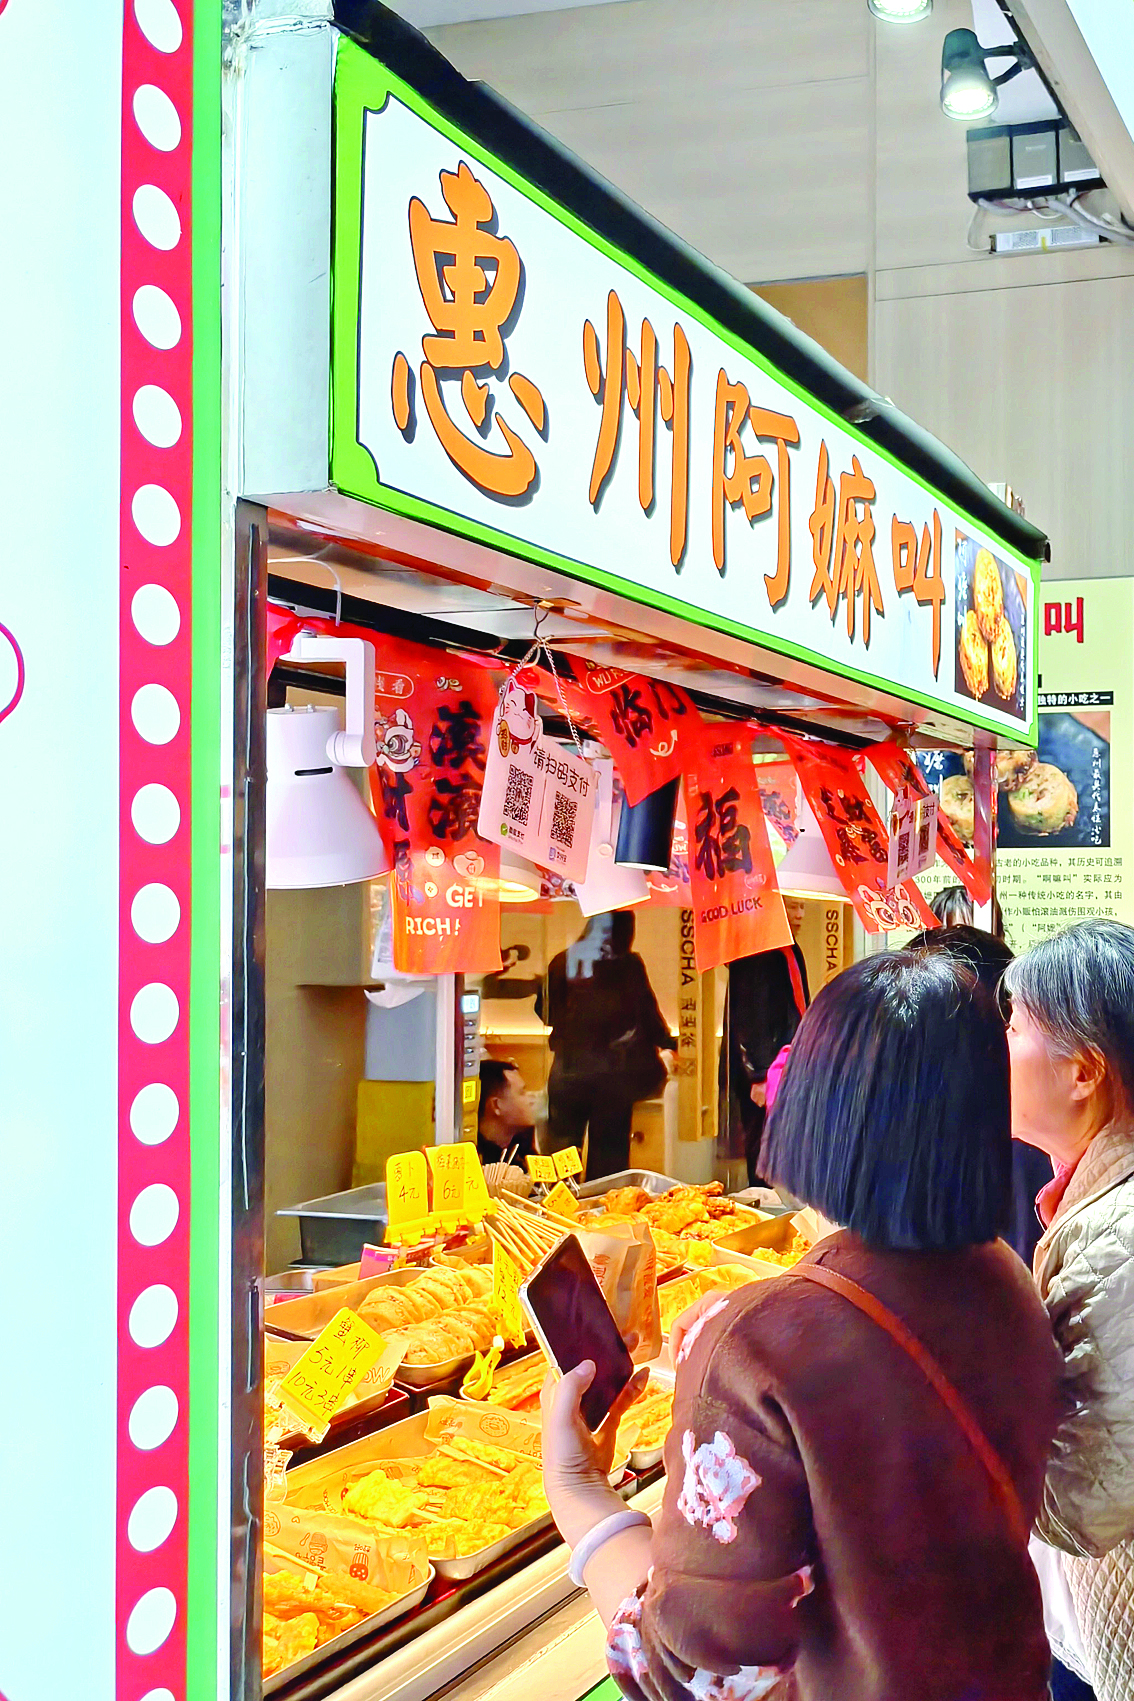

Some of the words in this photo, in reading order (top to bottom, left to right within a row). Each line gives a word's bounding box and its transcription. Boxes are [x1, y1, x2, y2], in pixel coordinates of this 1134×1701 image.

[392, 161, 945, 682] 惠州阿嫲叫
[1044, 597, 1085, 643] 叫
[533, 745, 591, 797] 请扫码支付
[695, 786, 753, 881] 福
[701, 906, 728, 923] GOOD
[731, 897, 763, 915] LUCK
[826, 909, 839, 971] SSCHA
[681, 909, 696, 986] SSCHA
